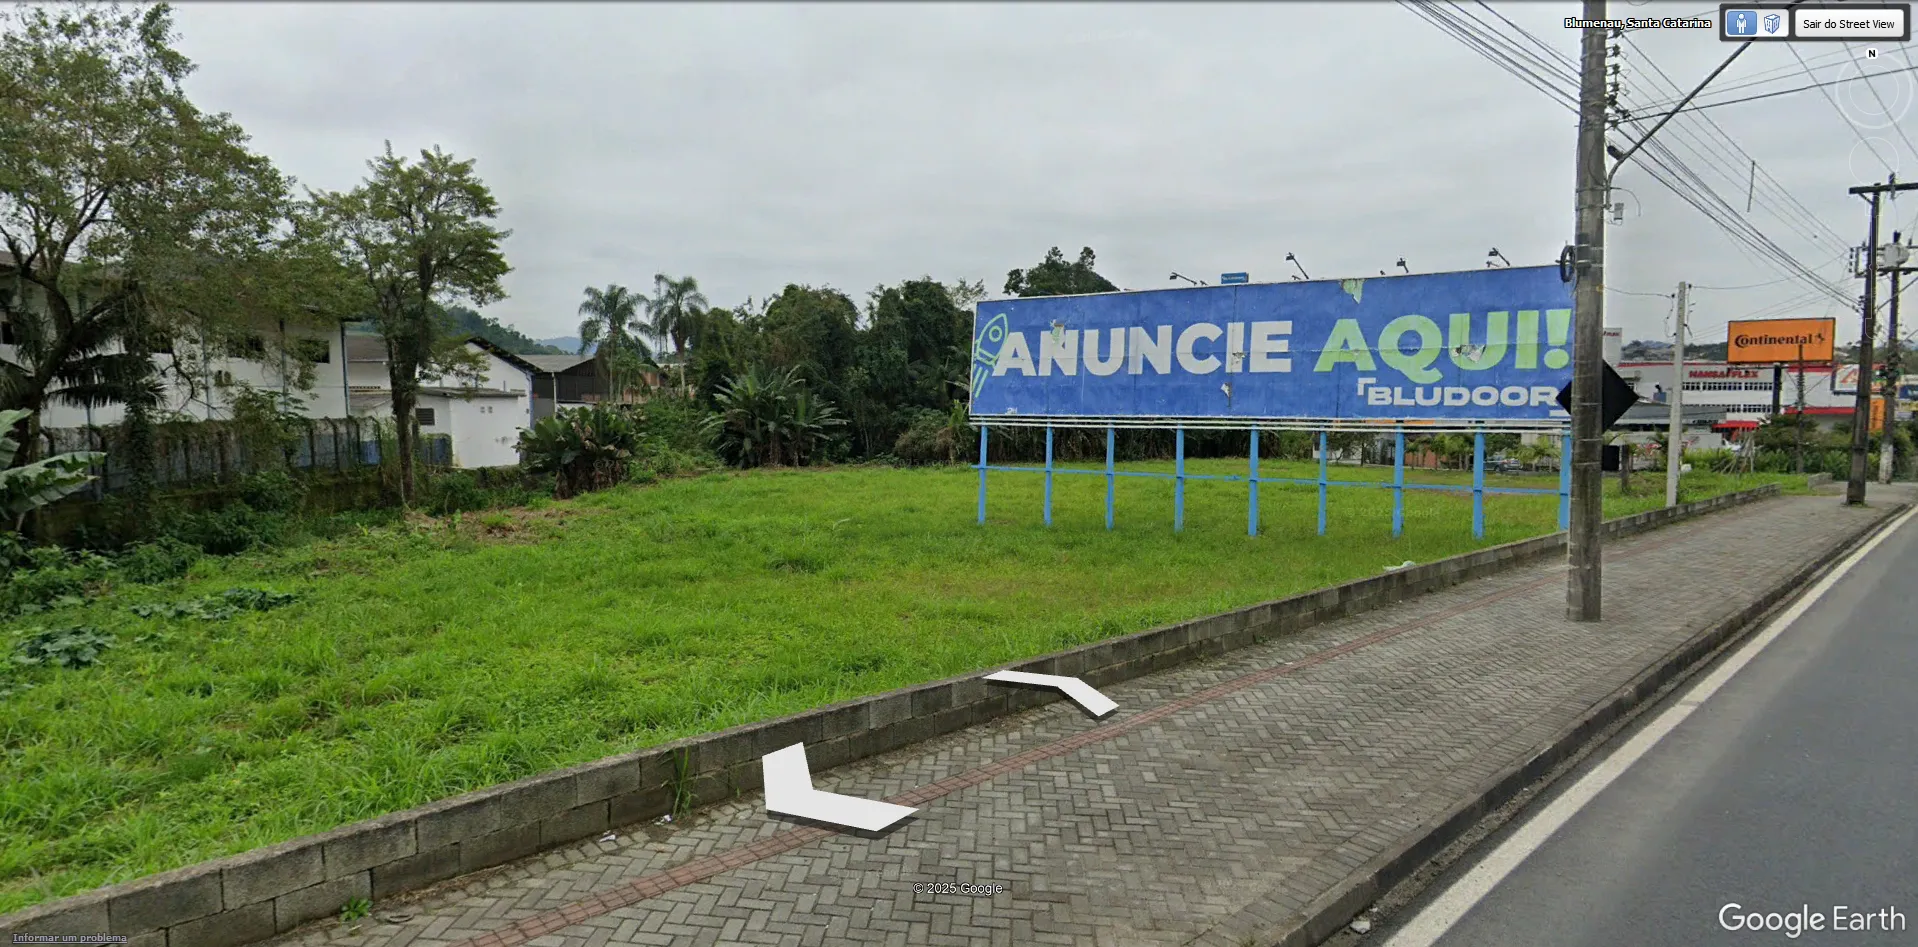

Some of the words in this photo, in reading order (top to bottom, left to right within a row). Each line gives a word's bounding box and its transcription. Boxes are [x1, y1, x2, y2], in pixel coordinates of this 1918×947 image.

[992, 319, 1292, 377] ANUNCIE
[1314, 309, 1572, 384] AQUI!
[1734, 333, 1813, 349] Continental
[1367, 386, 1559, 406] BLUDOOR
